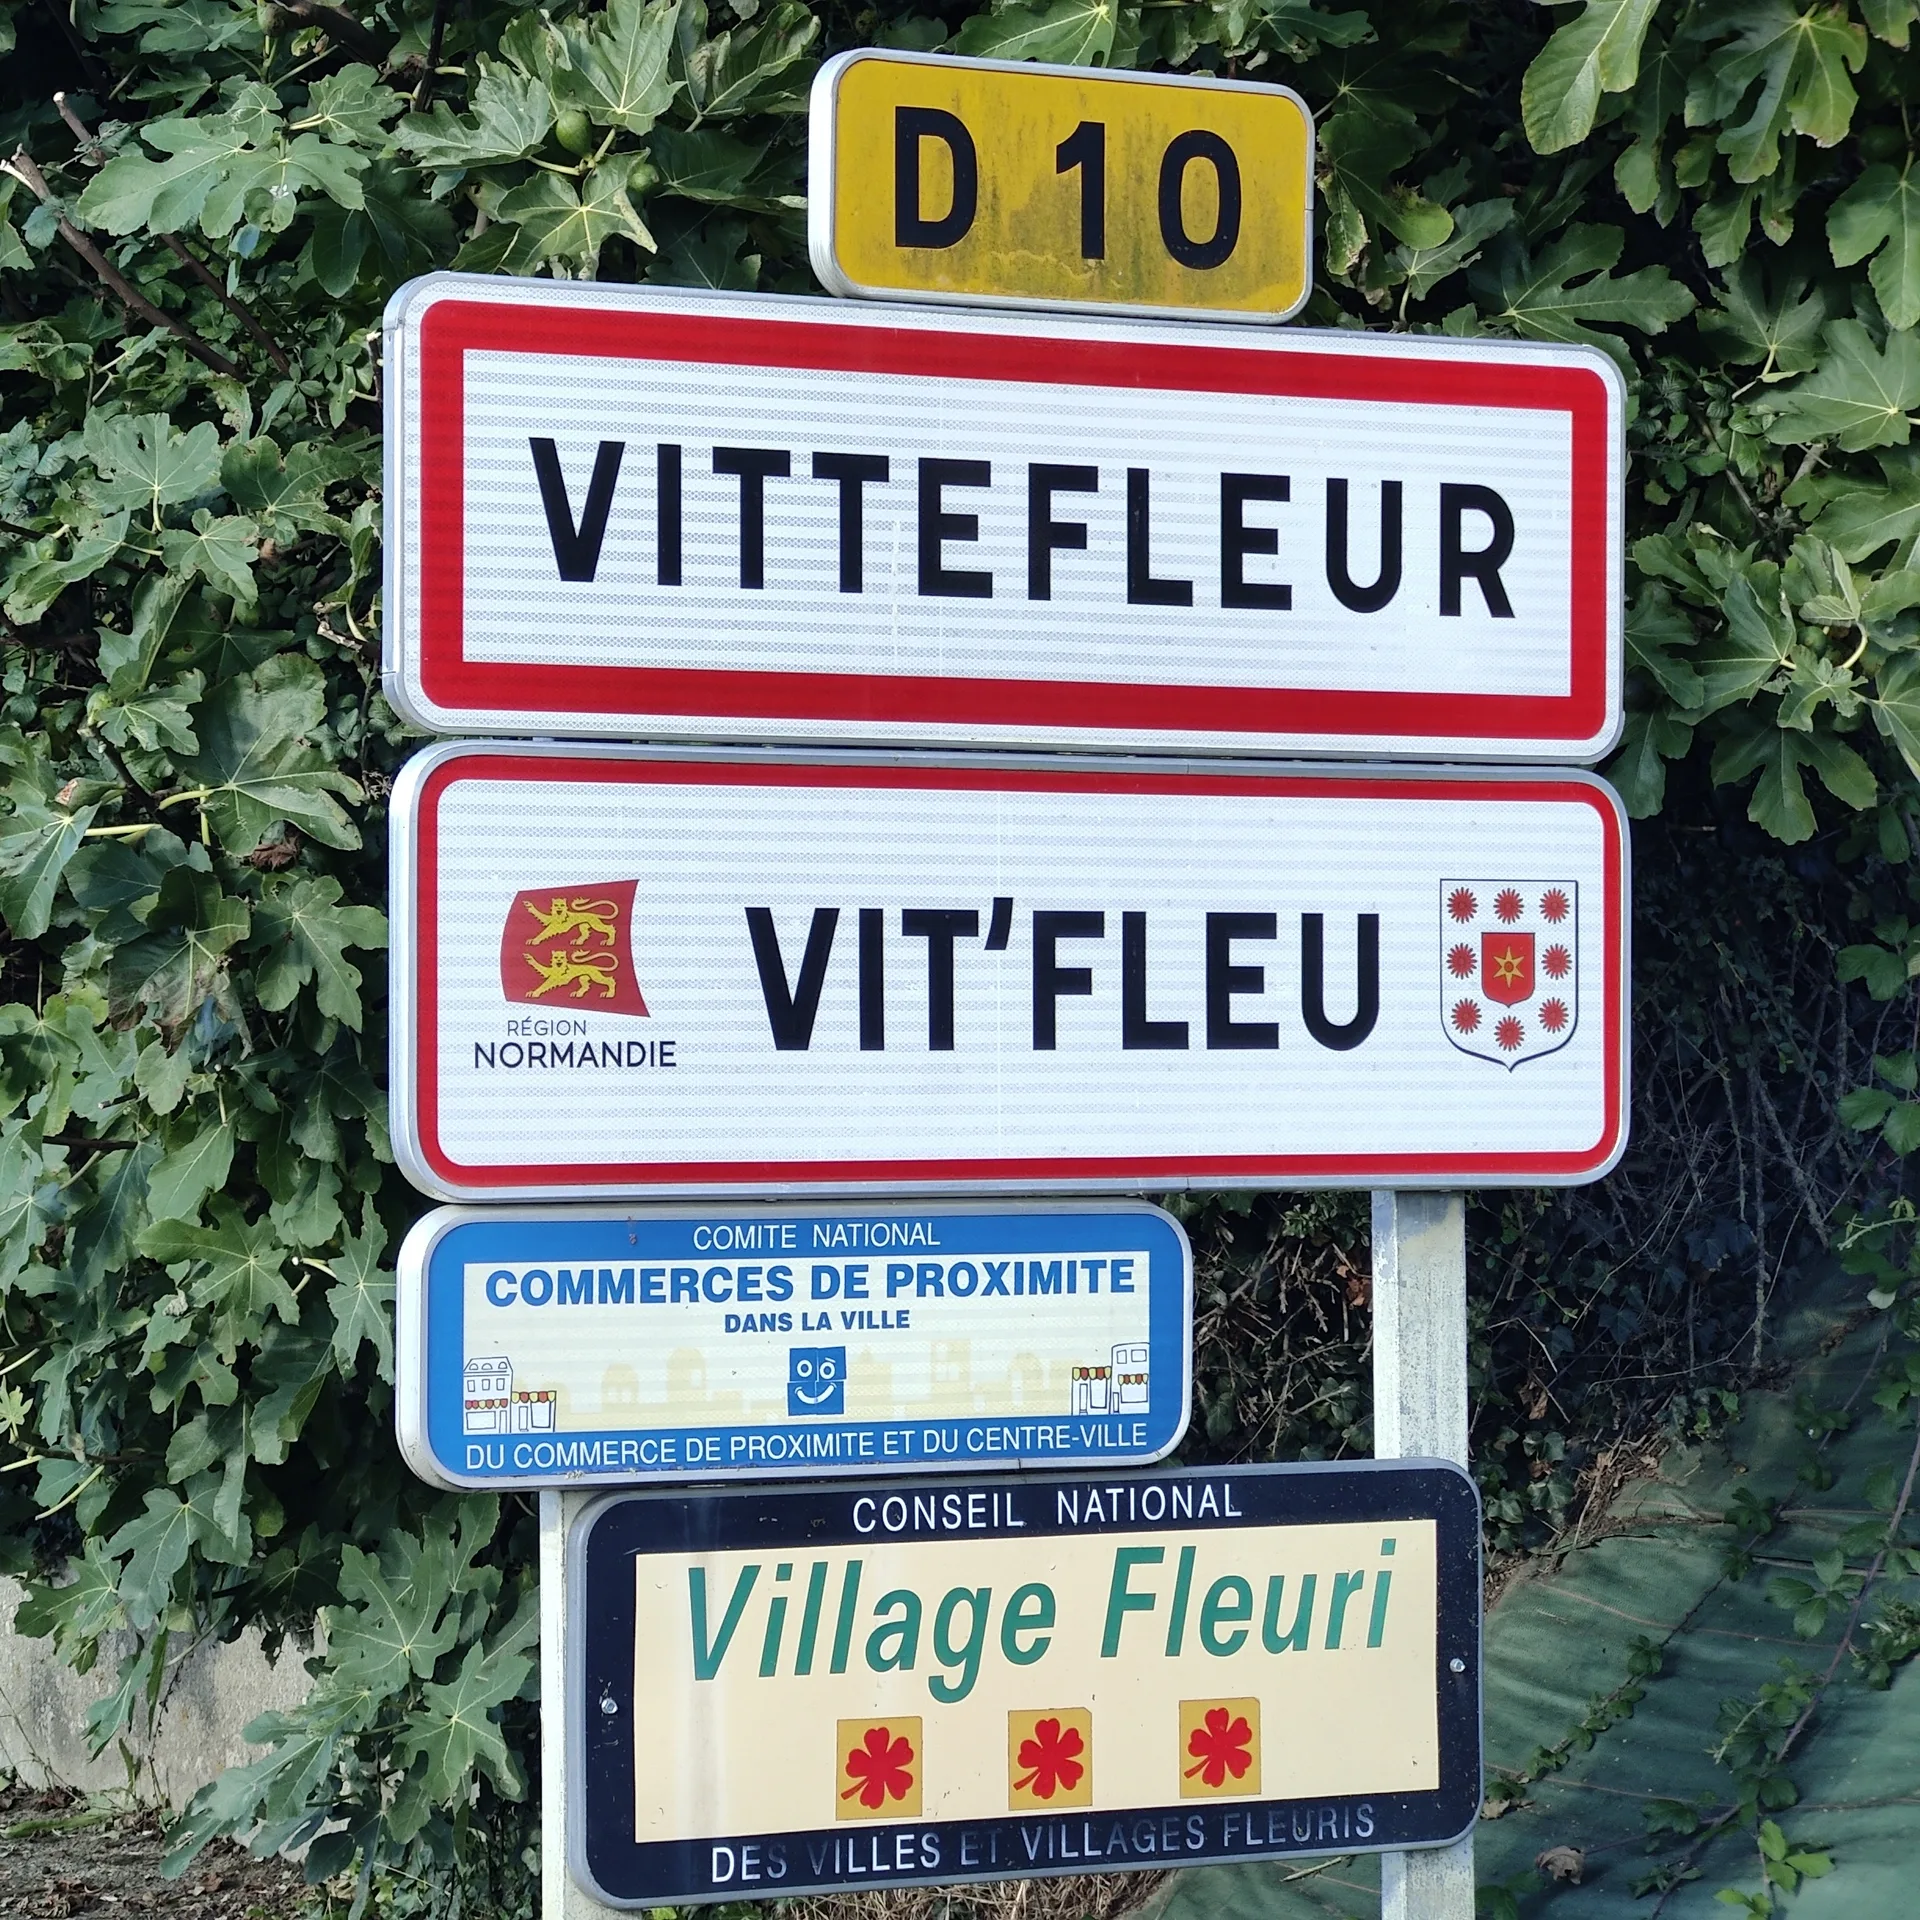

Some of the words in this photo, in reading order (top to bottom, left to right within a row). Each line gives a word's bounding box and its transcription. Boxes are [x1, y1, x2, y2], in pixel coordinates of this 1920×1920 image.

[895, 106, 977, 249] D
[1054, 120, 1242, 271] 10
[528, 436, 1516, 619] VITTEFLEUR
[744, 896, 1380, 1051] VIT'FLEU
[506, 1015, 587, 1037] RÉGION
[473, 1040, 677, 1069] NORMANDIE
[692, 1224, 797, 1252] COMITE
[811, 1222, 941, 1249] NATIONAL
[484, 1264, 796, 1308] COMMERCES
[809, 1263, 870, 1301] DE
[886, 1258, 1135, 1299] PROXIMITE
[724, 1312, 796, 1335] DANS
[800, 1312, 835, 1332] LA
[839, 1309, 910, 1331] VILLE
[466, 1443, 505, 1471] DU
[512, 1438, 677, 1469] COMMERCE
[685, 1437, 723, 1462] DE
[729, 1432, 874, 1460] PROXIMITE
[882, 1431, 918, 1455] ET
[925, 1429, 964, 1455] DU
[966, 1423, 1147, 1452] CENTRE-VILLE
[852, 1491, 1024, 1533] CONSEIL
[1056, 1484, 1242, 1523] NATIONAL
[687, 1559, 1057, 1704] Village
[1100, 1537, 1397, 1659] Fleuri
[710, 1843, 787, 1883] DES
[809, 1831, 940, 1876] VILLES
[959, 1828, 1001, 1866] ET
[1020, 1815, 1206, 1861] VILLAGES
[1222, 1803, 1375, 1847] FLEURIS
